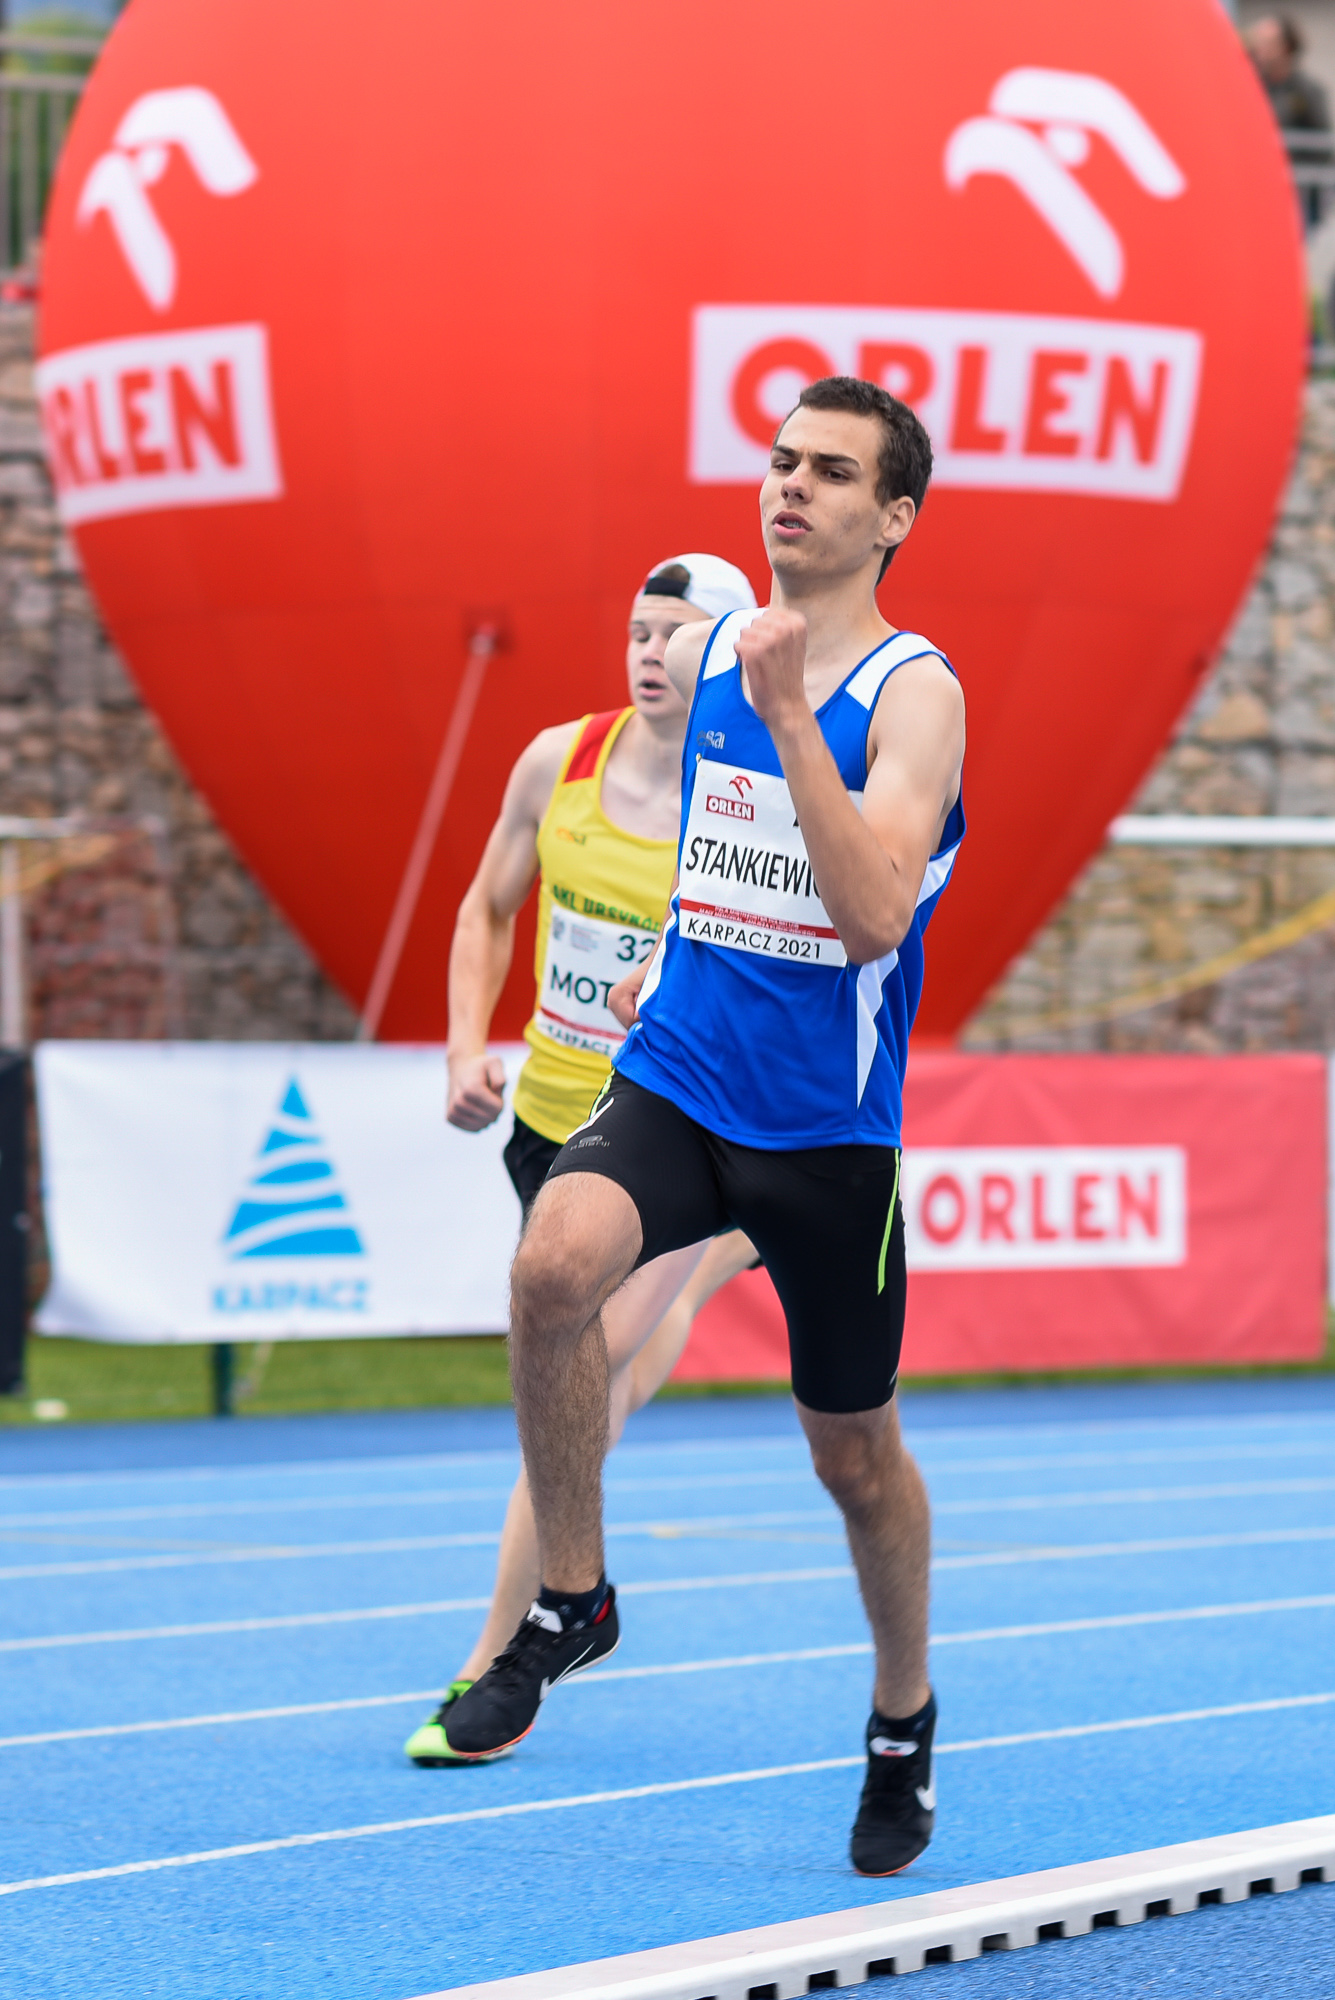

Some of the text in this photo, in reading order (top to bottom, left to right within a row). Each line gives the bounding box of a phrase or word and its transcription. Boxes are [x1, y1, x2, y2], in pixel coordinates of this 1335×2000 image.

[44, 360, 243, 488] RLEN
[730, 336, 1170, 468] ORLEN
[708, 797, 752, 820] ORLEN
[685, 836, 821, 898] STANKIEWI
[687, 918, 772, 951] KARPACZ
[777, 937, 821, 959] 2021
[921, 1173, 1160, 1245] ORLEN
[213, 1281, 369, 1313] KARPACZ
